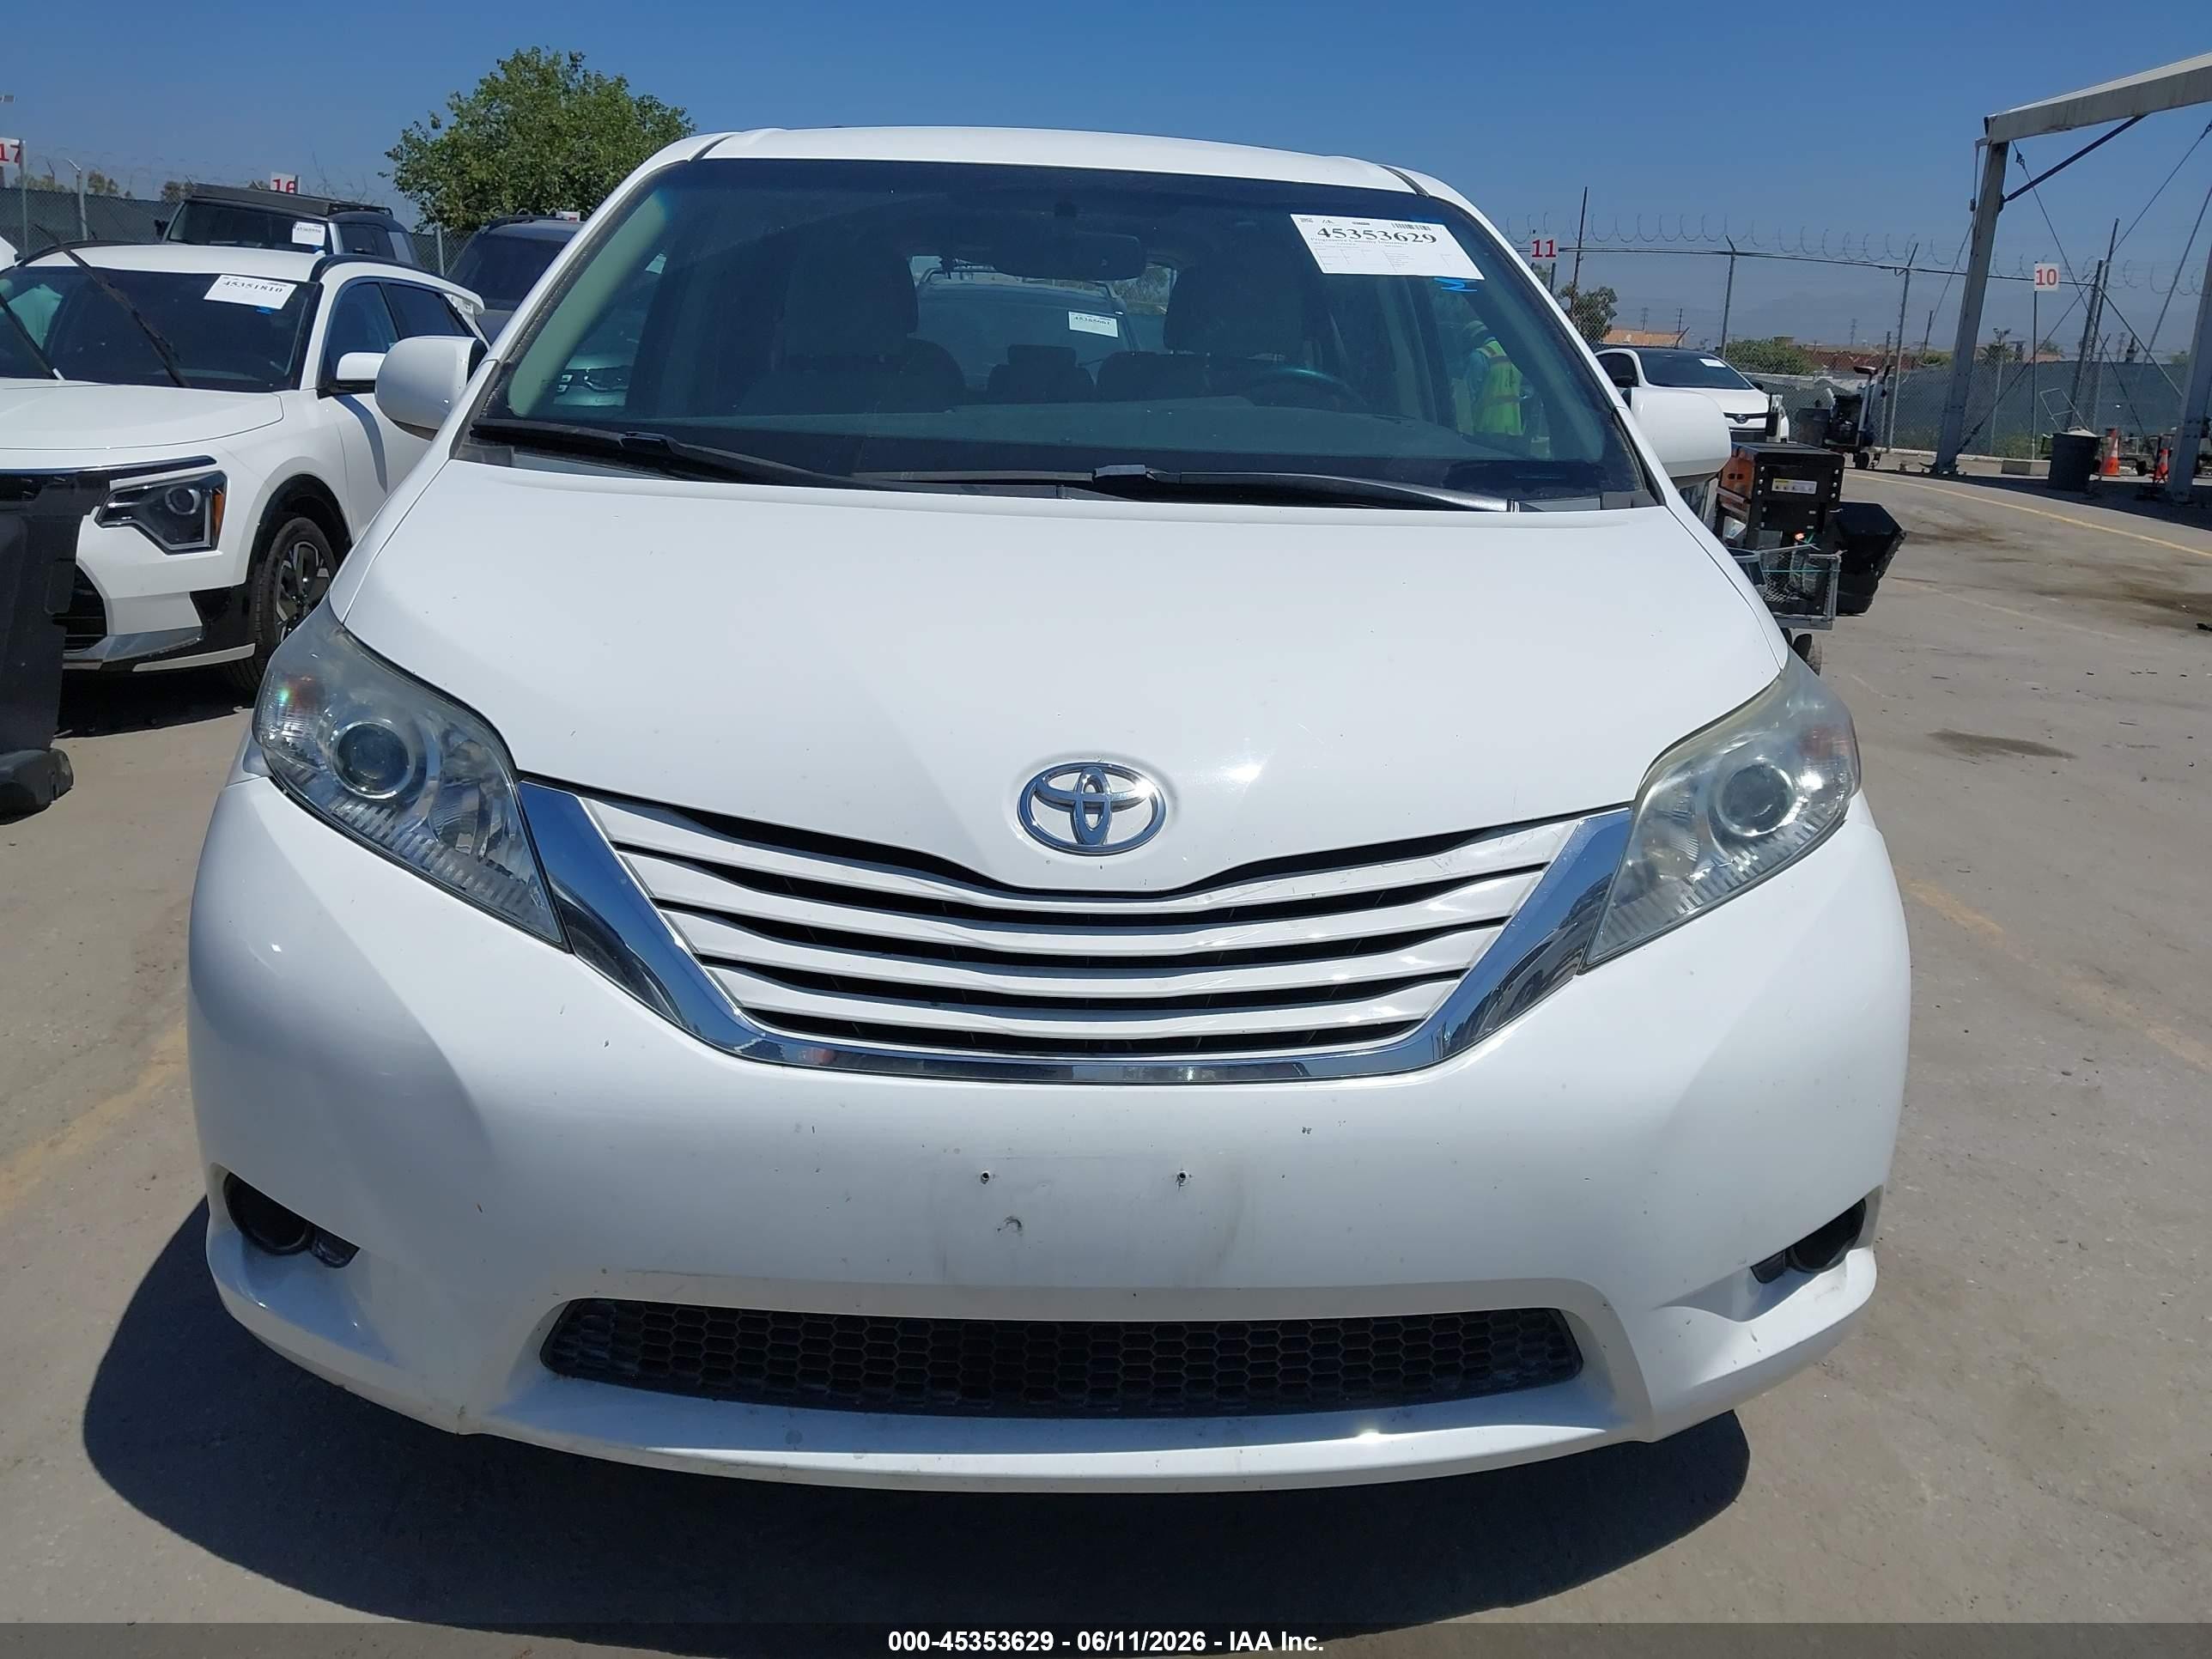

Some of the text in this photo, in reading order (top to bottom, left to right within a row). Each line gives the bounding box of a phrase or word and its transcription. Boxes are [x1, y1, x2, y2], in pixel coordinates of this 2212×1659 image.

[0, 143, 21, 163] 17
[1316, 227, 1437, 244] 45353629
[1531, 239, 1557, 258] 11
[2036, 268, 2057, 286] 10
